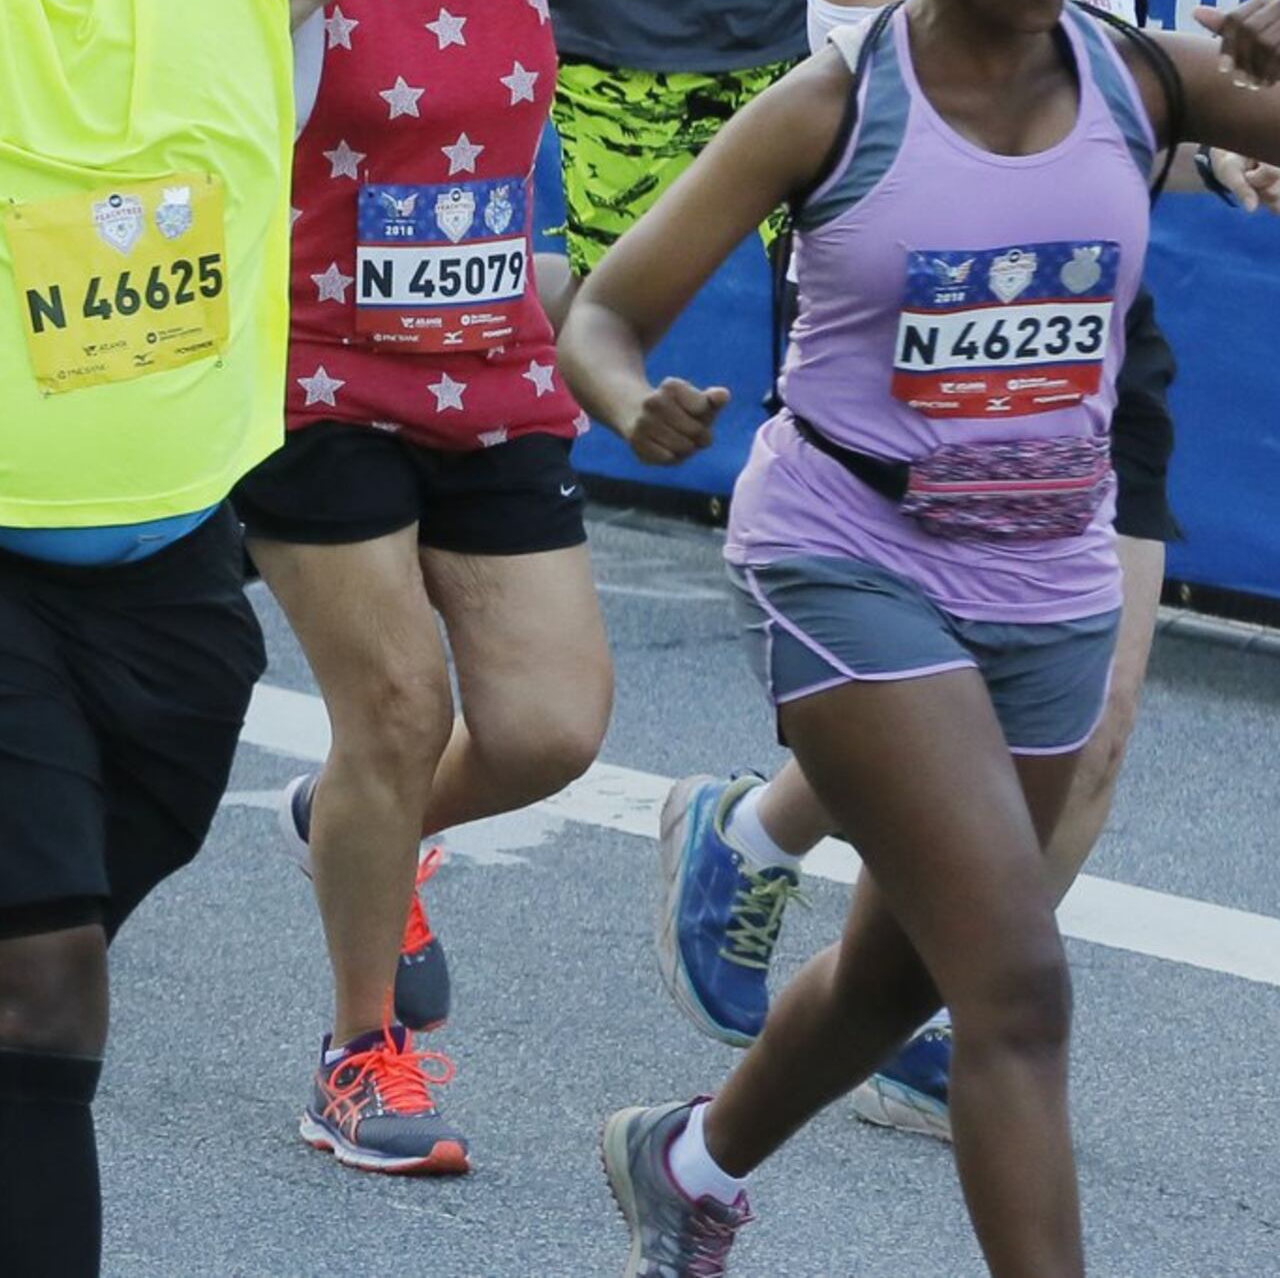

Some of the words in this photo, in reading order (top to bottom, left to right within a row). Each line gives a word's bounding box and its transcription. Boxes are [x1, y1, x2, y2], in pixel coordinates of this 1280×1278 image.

[385, 225, 414, 236] 2018
[26, 284, 68, 334] N
[82, 253, 223, 320] 46625
[362, 260, 393, 298] N
[408, 251, 523, 298] 45079
[900, 324, 939, 365] N
[951, 315, 1104, 360] 46233
